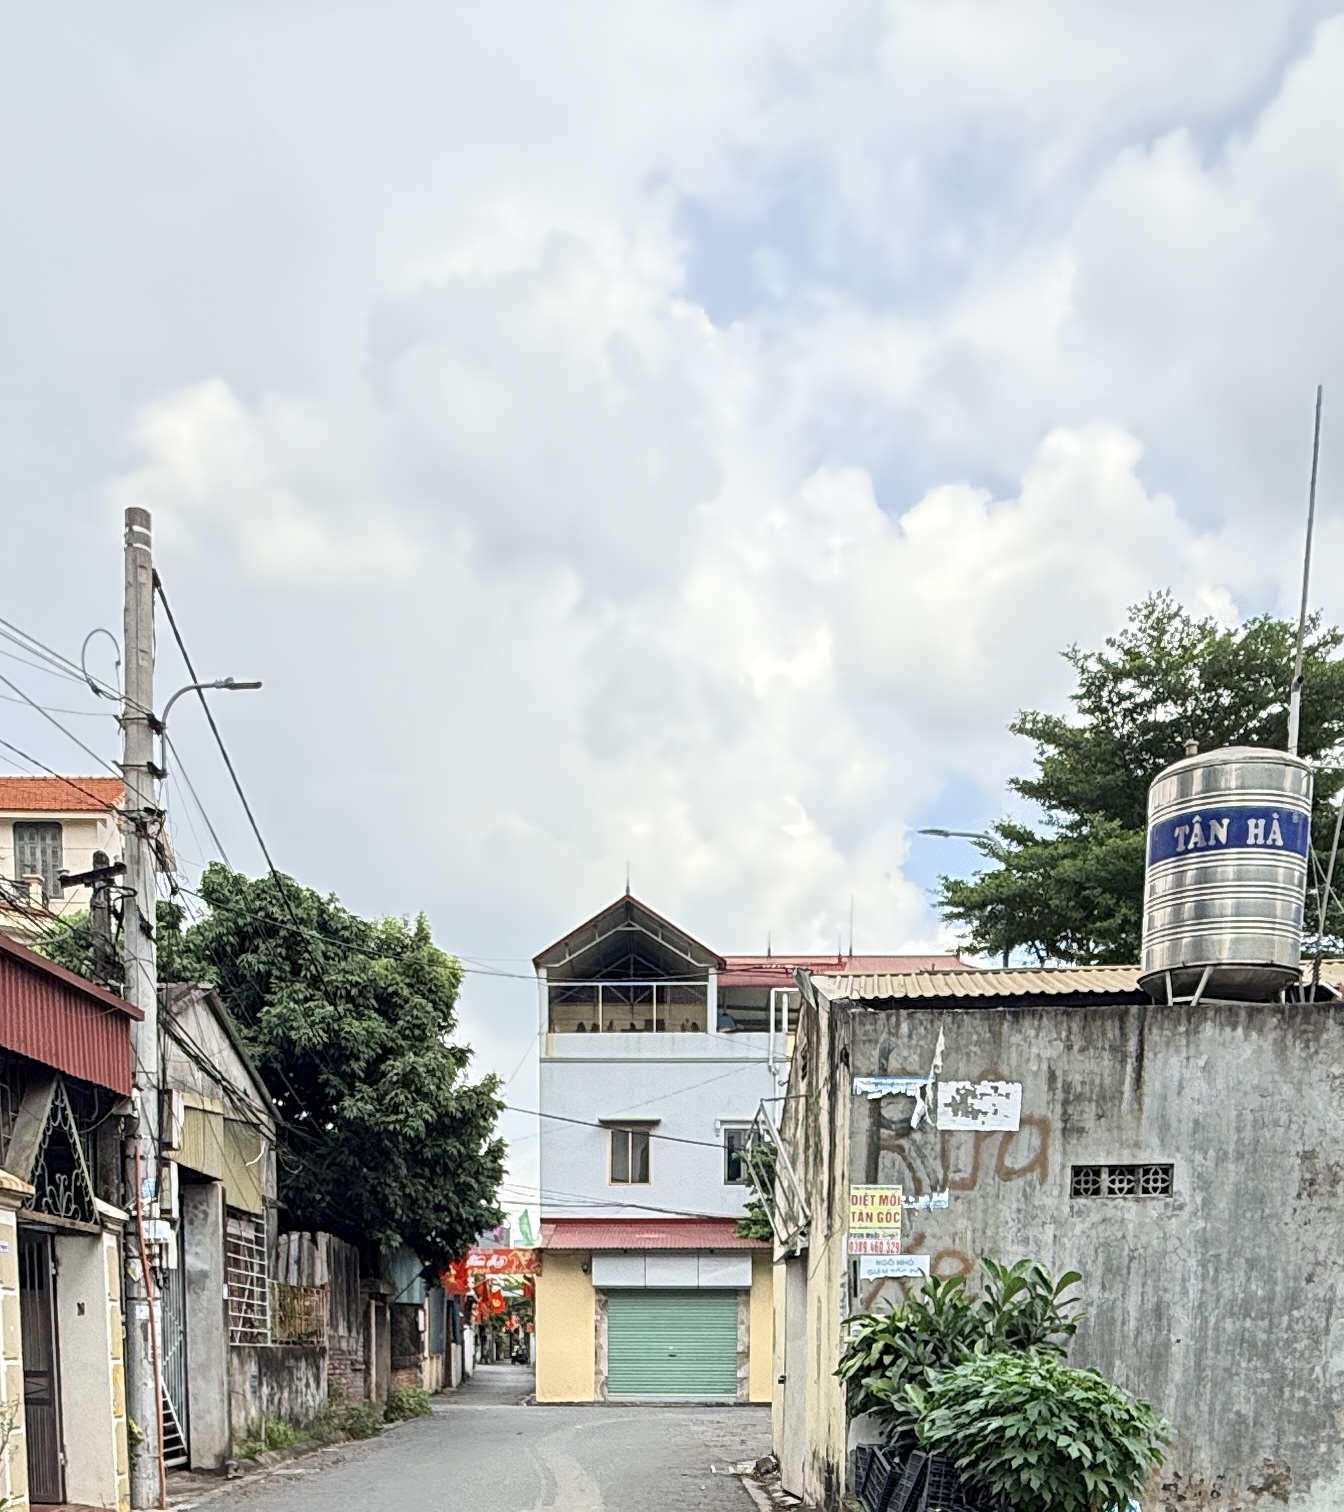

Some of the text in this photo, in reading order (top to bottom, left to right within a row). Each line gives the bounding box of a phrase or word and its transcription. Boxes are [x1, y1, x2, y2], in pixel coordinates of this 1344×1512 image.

[1173, 812, 1284, 852] TÂN HÀ
[851, 1189, 902, 1210] DIỆT MỐI
[876, 1207, 901, 1224] GỐC
